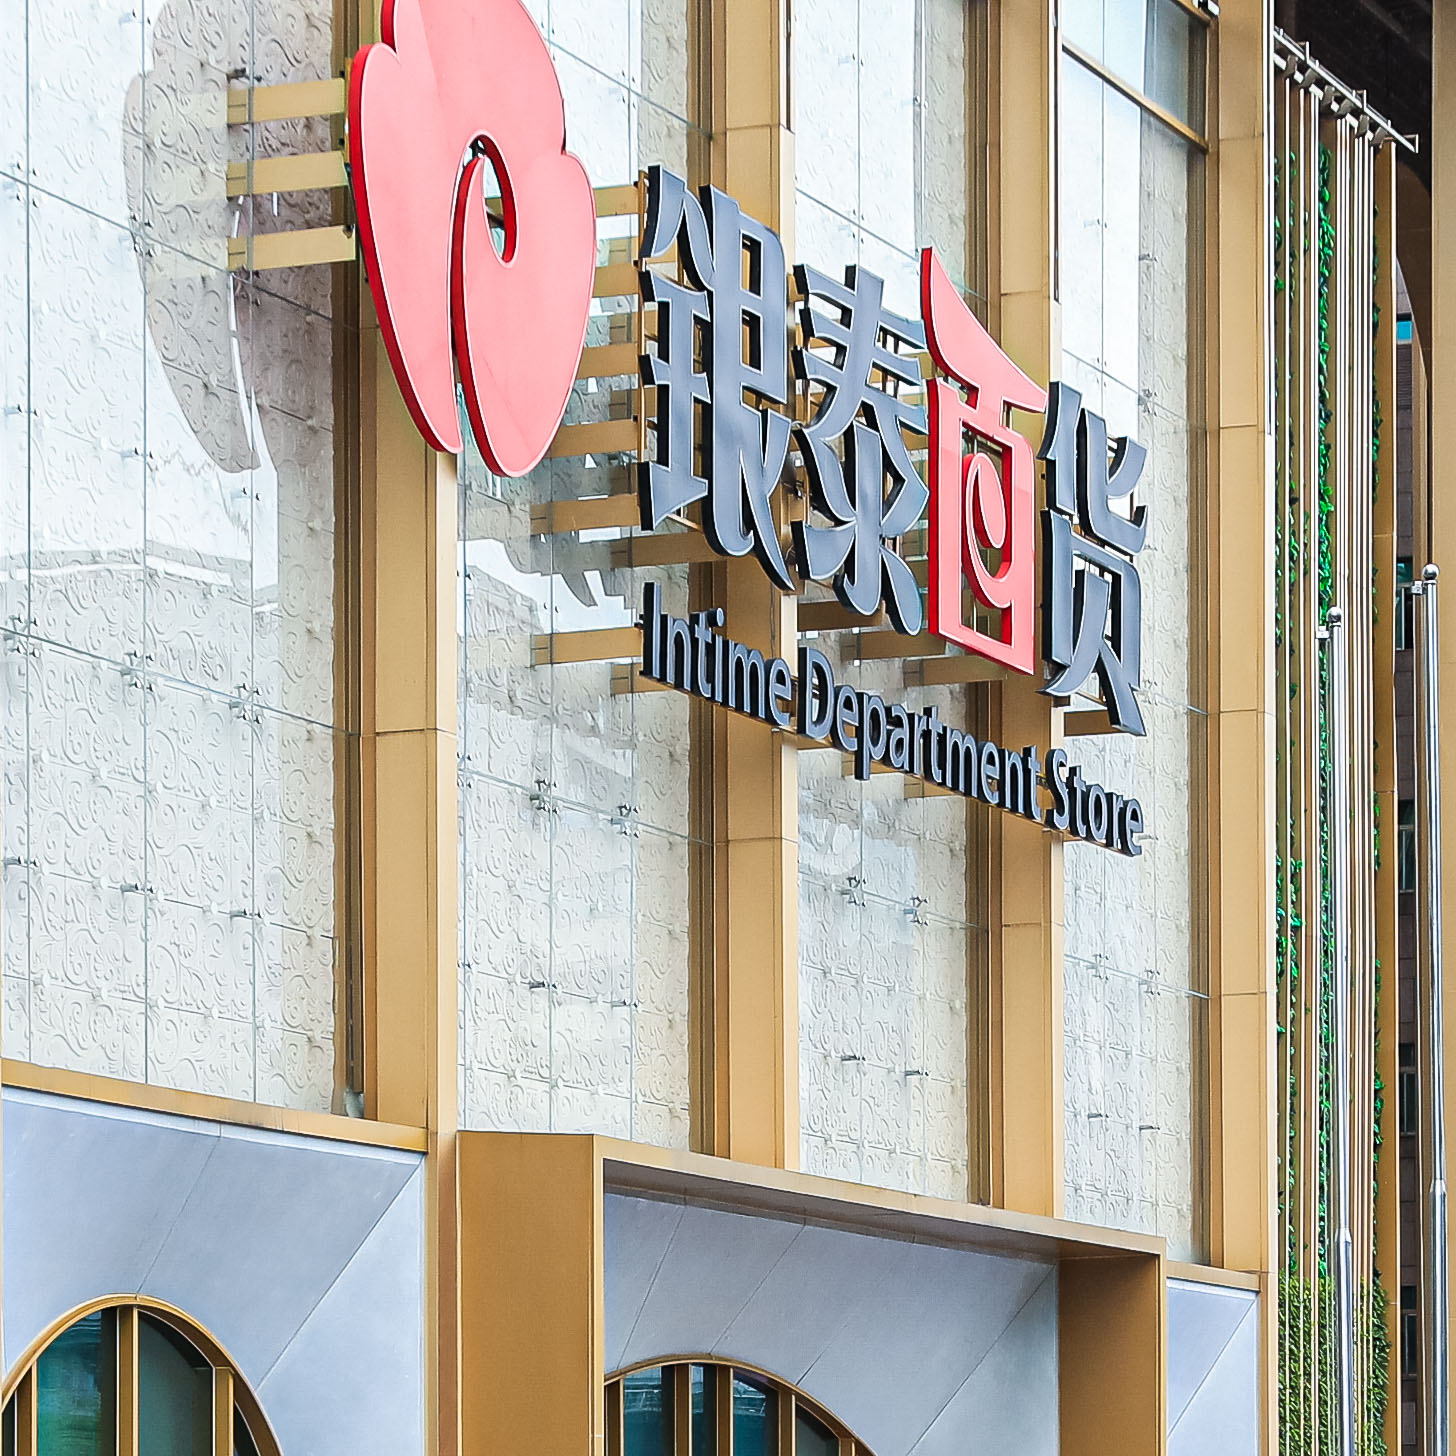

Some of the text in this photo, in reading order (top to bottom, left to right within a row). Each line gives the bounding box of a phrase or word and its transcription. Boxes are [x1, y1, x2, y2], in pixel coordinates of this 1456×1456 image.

[641, 164, 1146, 736] 银泰百货
[641, 581, 1144, 857] Intime Department Store
